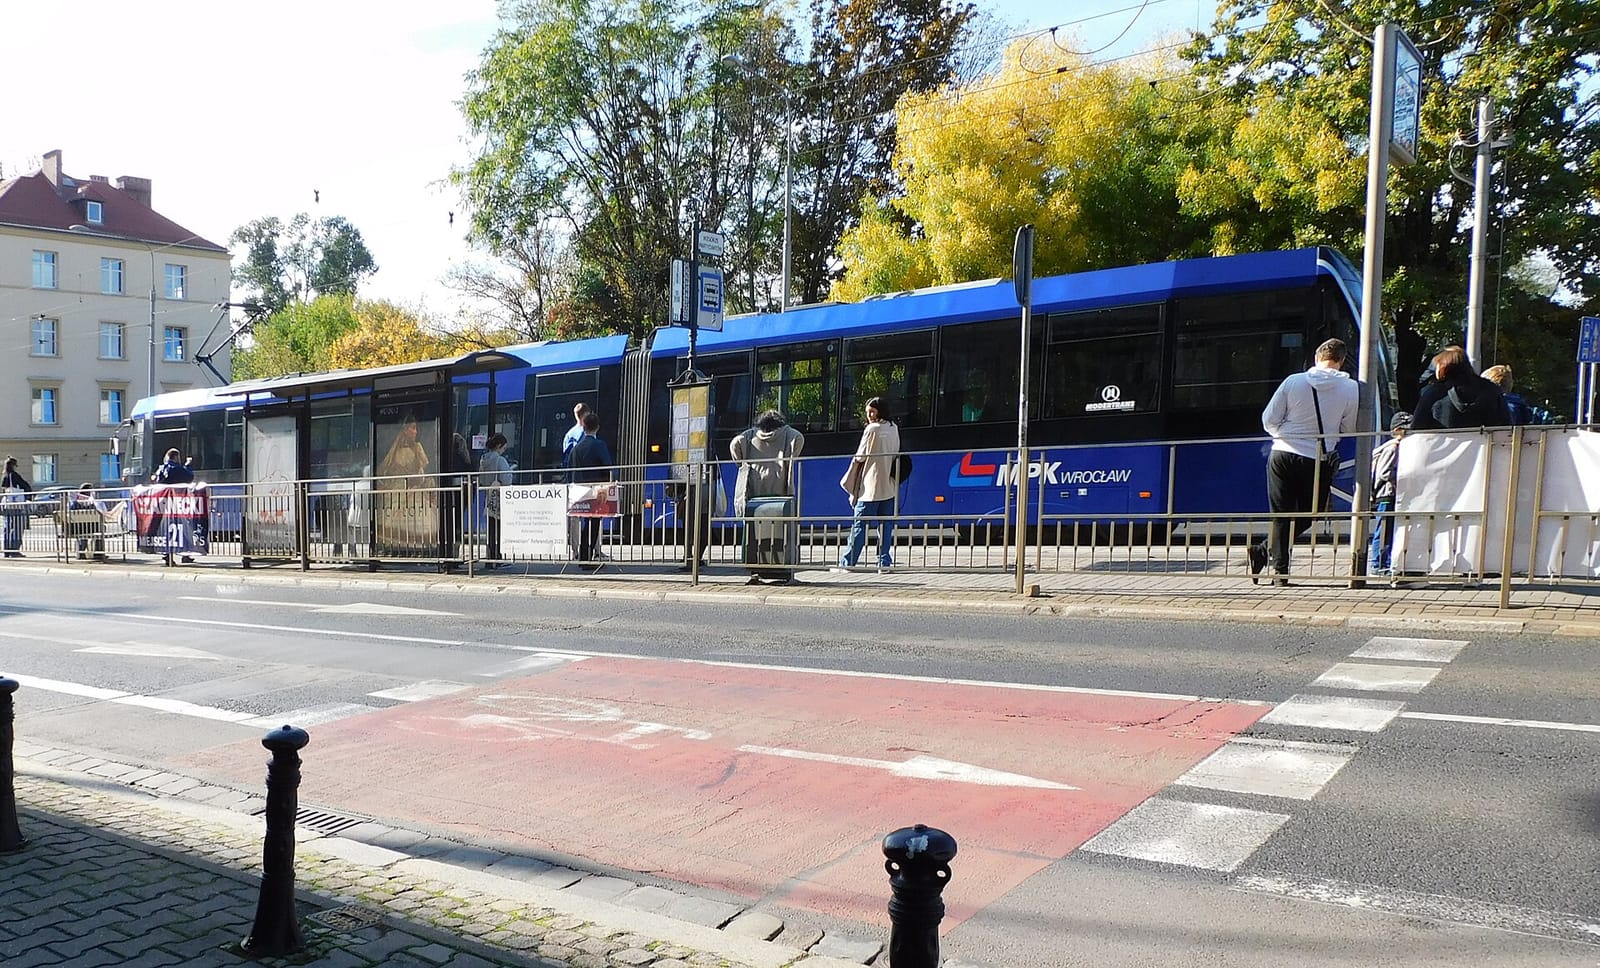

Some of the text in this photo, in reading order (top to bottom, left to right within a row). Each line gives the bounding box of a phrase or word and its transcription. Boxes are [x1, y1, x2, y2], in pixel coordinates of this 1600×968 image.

[1085, 400, 1136, 412] MODERTRANS
[996, 461, 1132, 487] MPK WROCŁAW
[505, 489, 562, 500] SOBOLAK
[168, 523, 184, 548] 21
